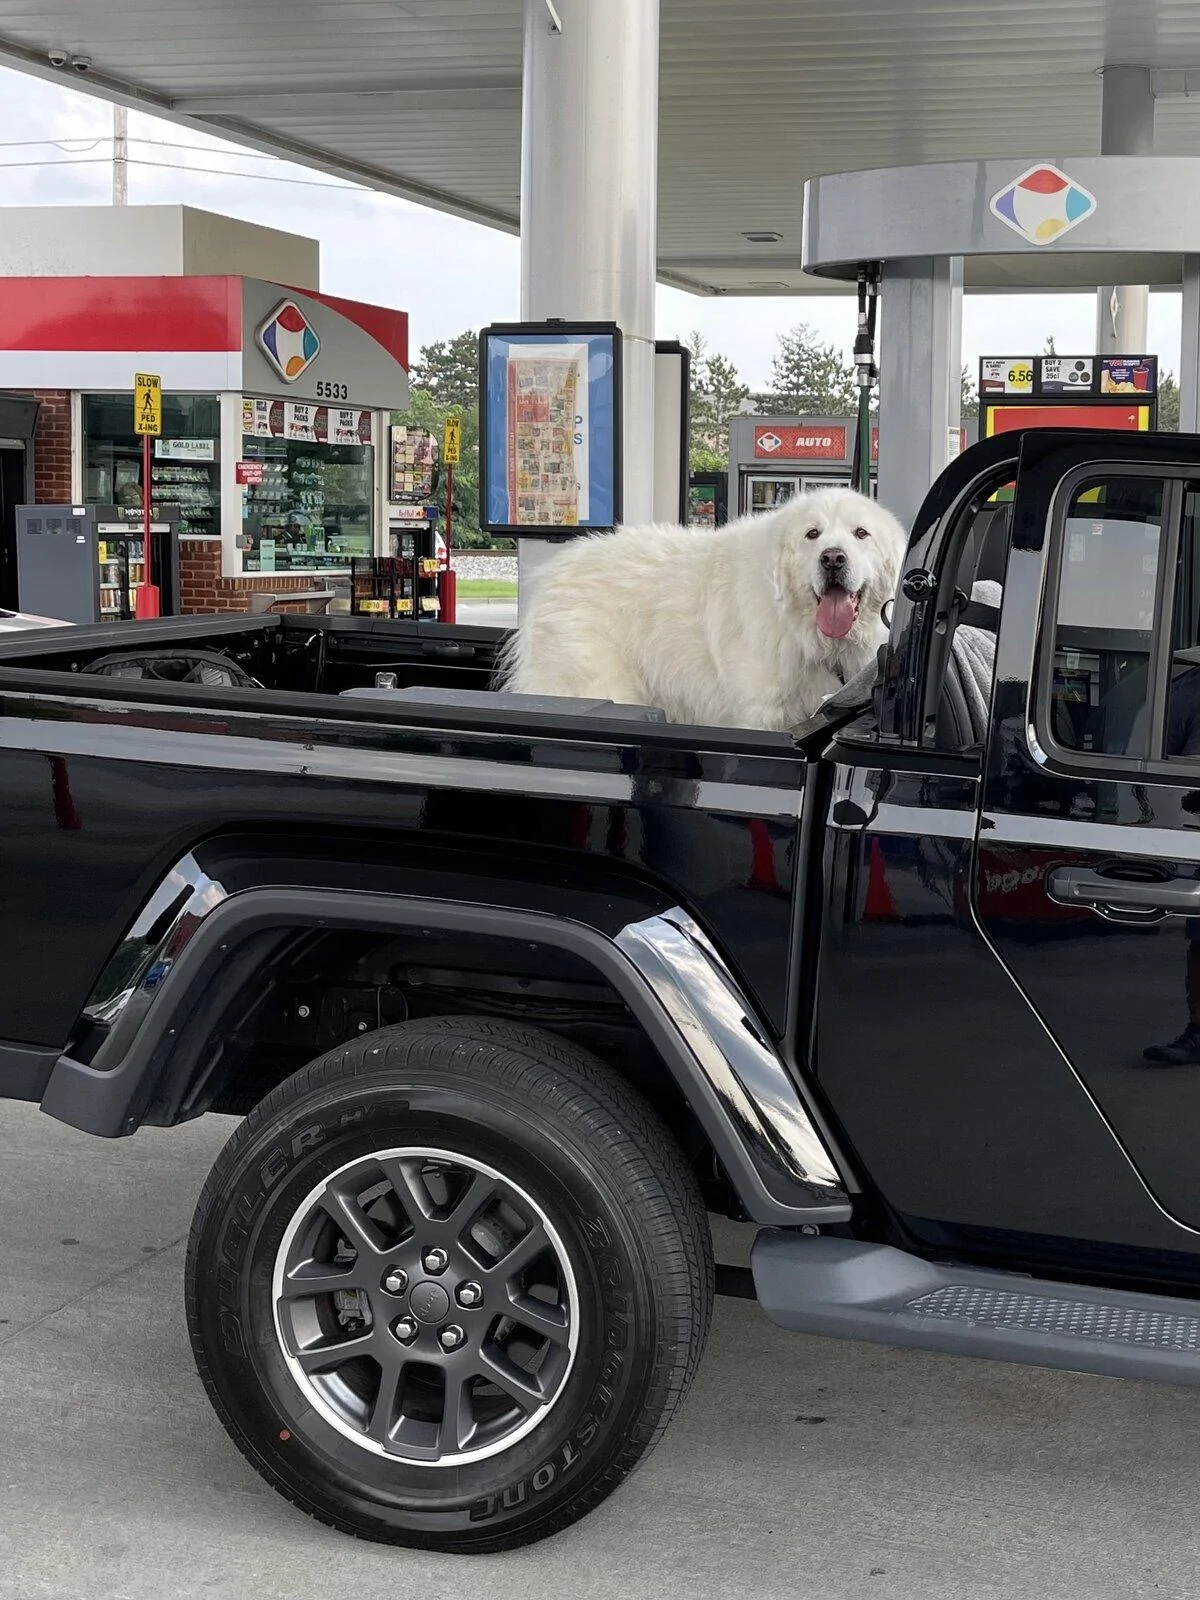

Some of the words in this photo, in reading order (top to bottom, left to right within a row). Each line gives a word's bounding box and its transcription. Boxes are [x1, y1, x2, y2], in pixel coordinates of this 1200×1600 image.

[1008, 370, 1034, 382] 6.56
[138, 376, 158, 388] SLOW
[316, 381, 348, 400] 5533
[294, 404, 304, 414] BUY
[305, 406, 308, 414] 2
[141, 414, 156, 422] PED
[294, 414, 308, 422] PACKS
[138, 423, 158, 432] X-ING
[191, 441, 210, 450] LABEL
[796, 437, 832, 446] AUTO
